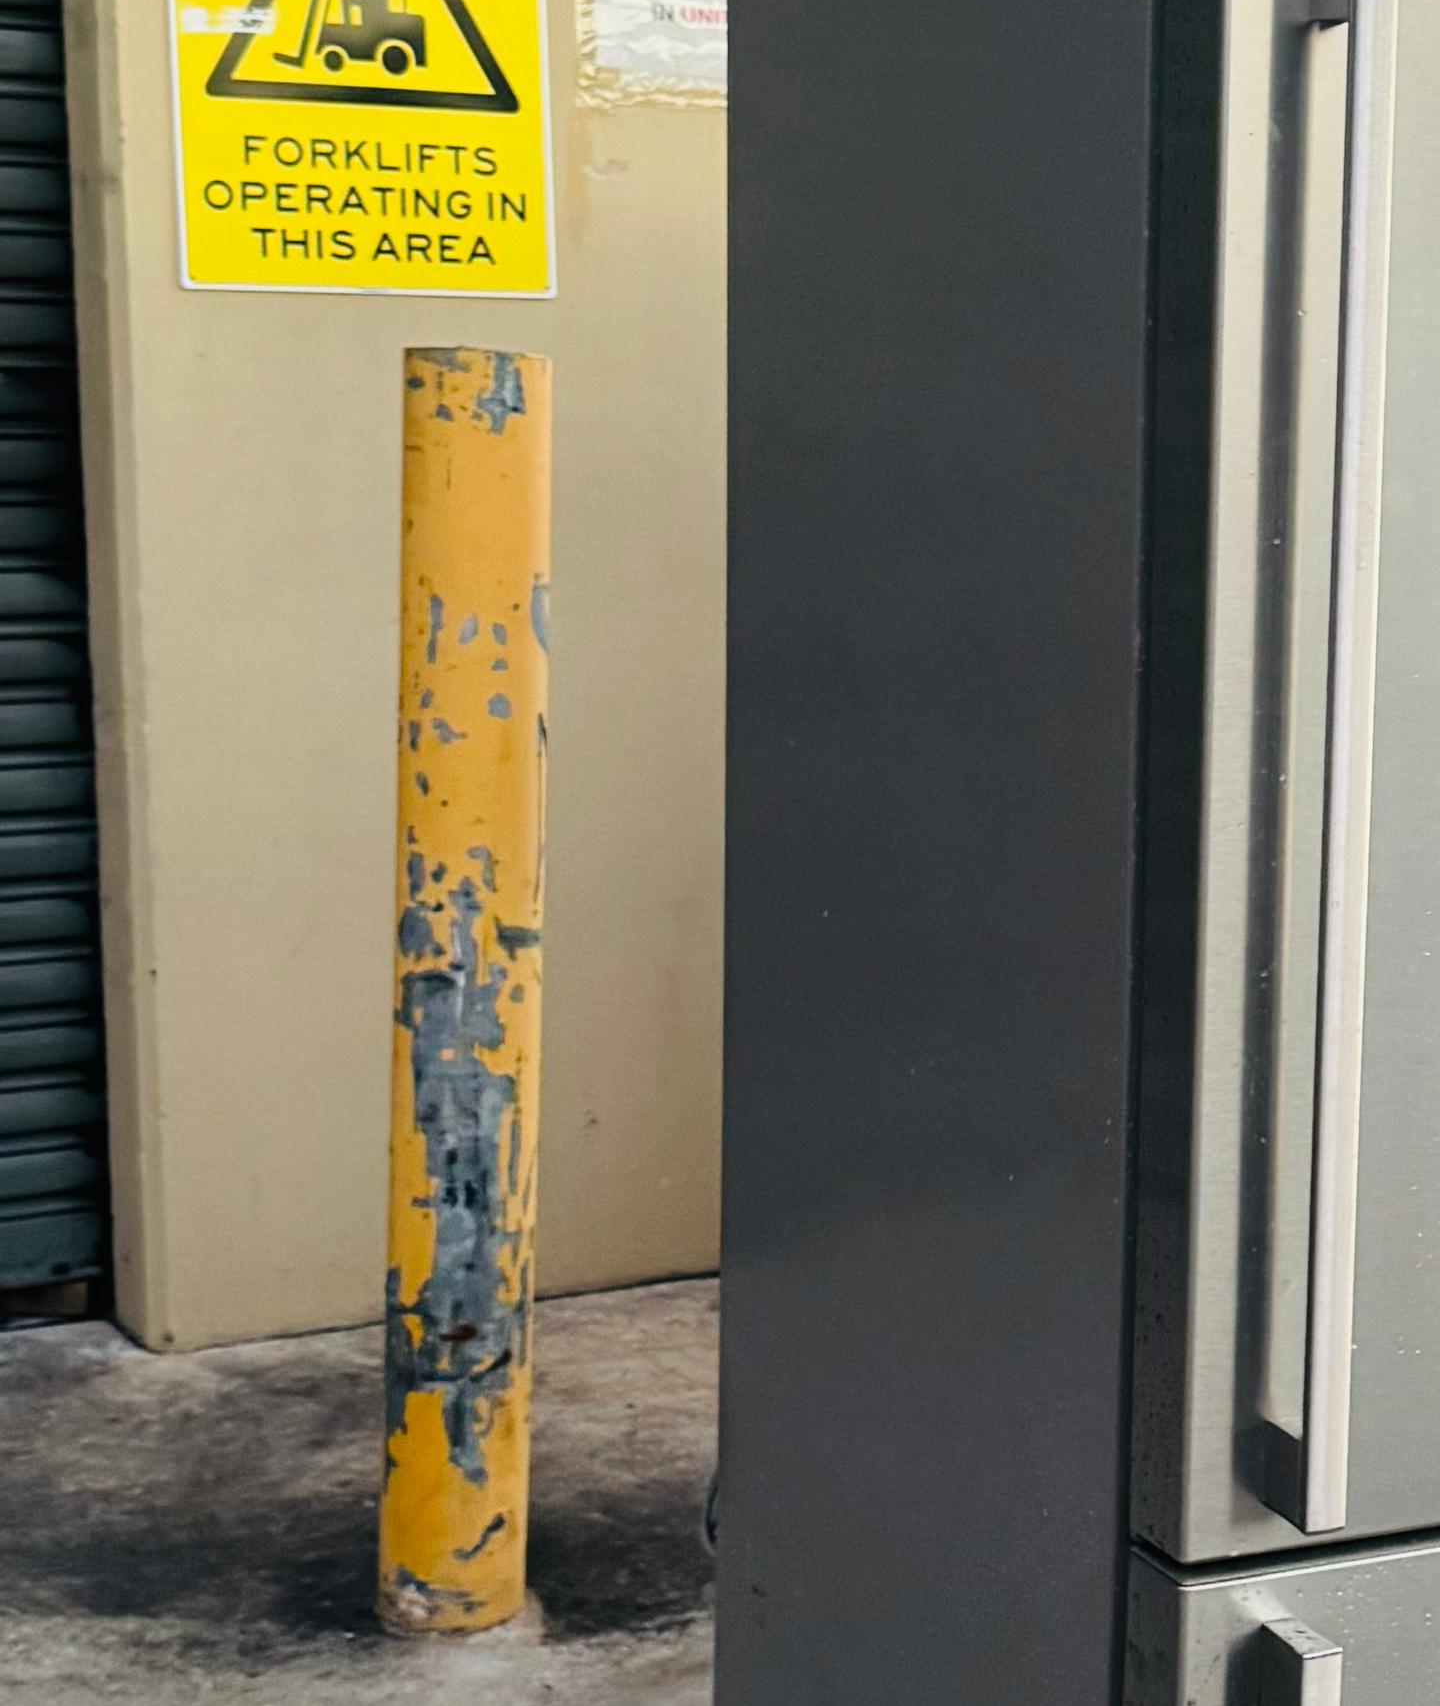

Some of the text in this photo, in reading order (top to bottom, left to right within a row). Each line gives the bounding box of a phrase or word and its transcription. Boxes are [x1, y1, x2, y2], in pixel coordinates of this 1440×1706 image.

[652, 3, 675, 23] IN
[243, 135, 498, 177] FORKLIFTS
[203, 179, 528, 221] OPERATING IN
[251, 227, 497, 265] THIS AREA
